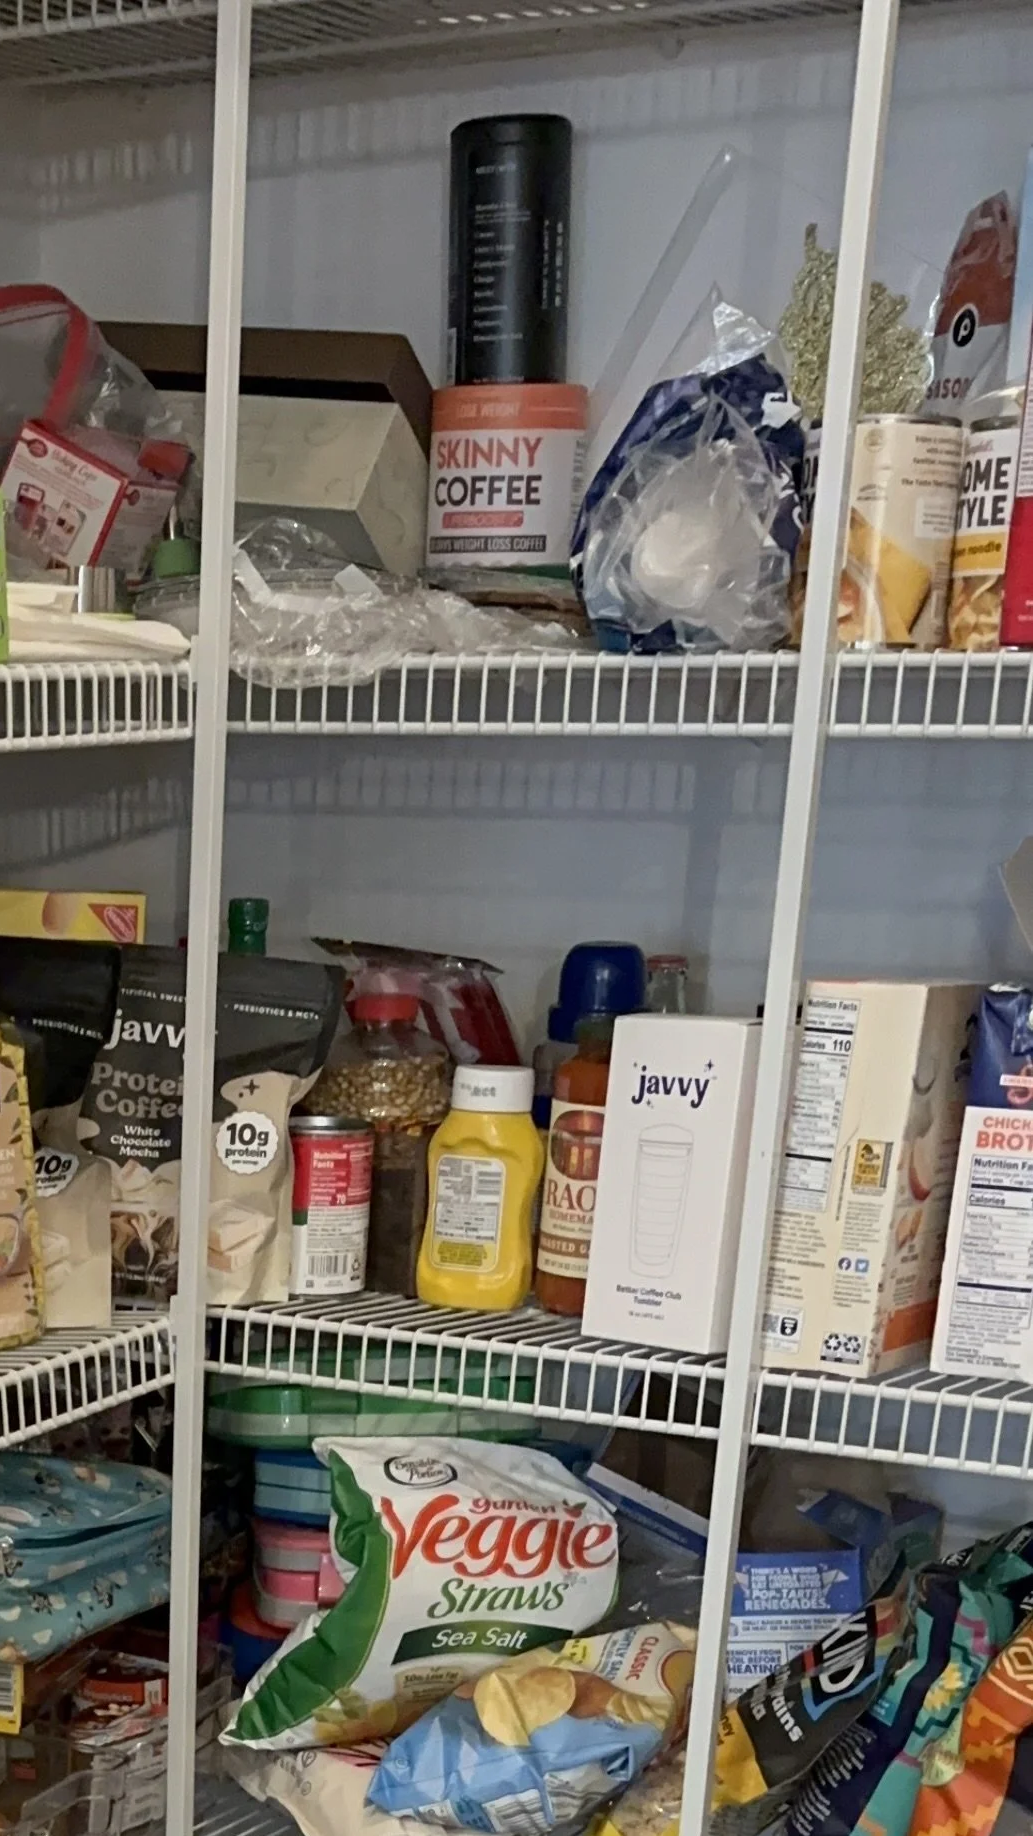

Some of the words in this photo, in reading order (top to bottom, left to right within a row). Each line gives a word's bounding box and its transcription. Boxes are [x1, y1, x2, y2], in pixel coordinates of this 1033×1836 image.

[437, 436, 543, 470] SKINNY
[434, 475, 542, 507] COFFEE
[487, 539, 511, 549] LOSS
[513, 537, 544, 549] COFFEE
[233, 1003, 285, 1017] PREBIOTICS
[808, 1000, 837, 1010] Nutrition
[838, 1001, 858, 1012] Facts
[32, 1018, 78, 1034] PREBIOTICS
[802, 1039, 826, 1051] Calories
[832, 1039, 852, 1053] 110
[91, 1062, 184, 1097] Protei
[631, 1064, 710, 1109] javvy
[124, 1124, 161, 1138] White
[982, 1115, 1031, 1131] CHICK
[111, 1134, 171, 1148] Chocolate
[225, 1122, 270, 1147] 10g
[975, 1130, 1033, 1151] BROT
[119, 1146, 160, 1159] Mocha
[224, 1147, 267, 1160] protein
[36, 1154, 72, 1175] 10g
[313, 1160, 334, 1169] Facts
[973, 1157, 1018, 1171] Nutrition
[547, 1179, 597, 1212] RAO
[968, 1193, 1006, 1206] Calories
[549, 1211, 594, 1225] HOMEMA
[616, 1284, 640, 1295] Better
[640, 1287, 664, 1298] Coffee
[665, 1290, 682, 1301] Club
[380, 1494, 617, 1580] Veggie
[427, 1578, 569, 1619] Straws
[745, 1600, 831, 1611] RENEGADES.
[432, 1628, 477, 1649] Sea
[481, 1627, 528, 1650] Salt
[626, 1635, 659, 1681] CLASSIC
[746, 1655, 781, 1663] BEFORE
[818, 1610, 868, 1694] KIND
